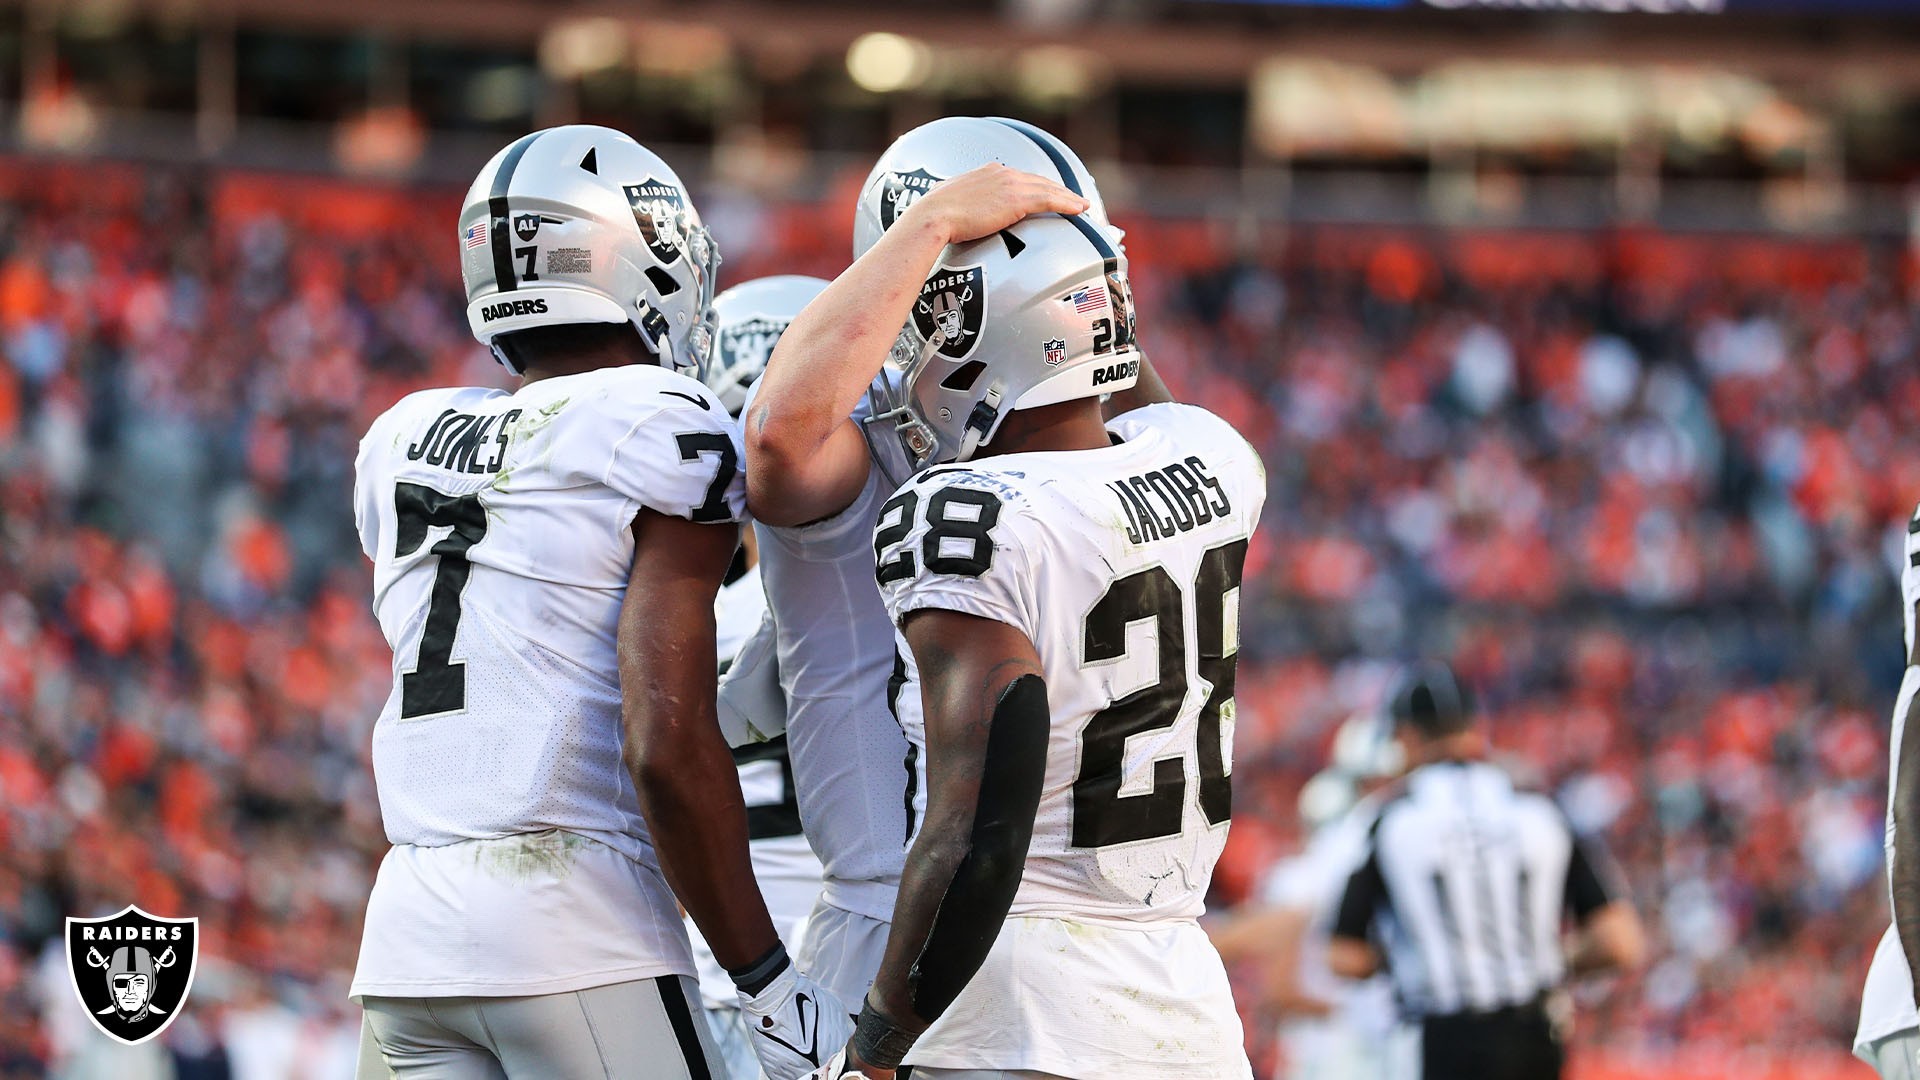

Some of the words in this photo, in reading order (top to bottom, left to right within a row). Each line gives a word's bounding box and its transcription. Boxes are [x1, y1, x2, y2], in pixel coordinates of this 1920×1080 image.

[630, 186, 678, 197] RAIDERS
[517, 218, 537, 231] AL
[515, 246, 539, 281] 7
[919, 271, 974, 295] AIDERS
[481, 299, 548, 323] RAIDERS
[1047, 350, 1065, 362] NFL
[408, 408, 522, 474] JONES
[676, 431, 738, 522] 7
[1107, 456, 1231, 544] JACOBS
[874, 486, 1003, 587] 28
[394, 480, 488, 720] 7
[1070, 537, 1250, 848] 28
